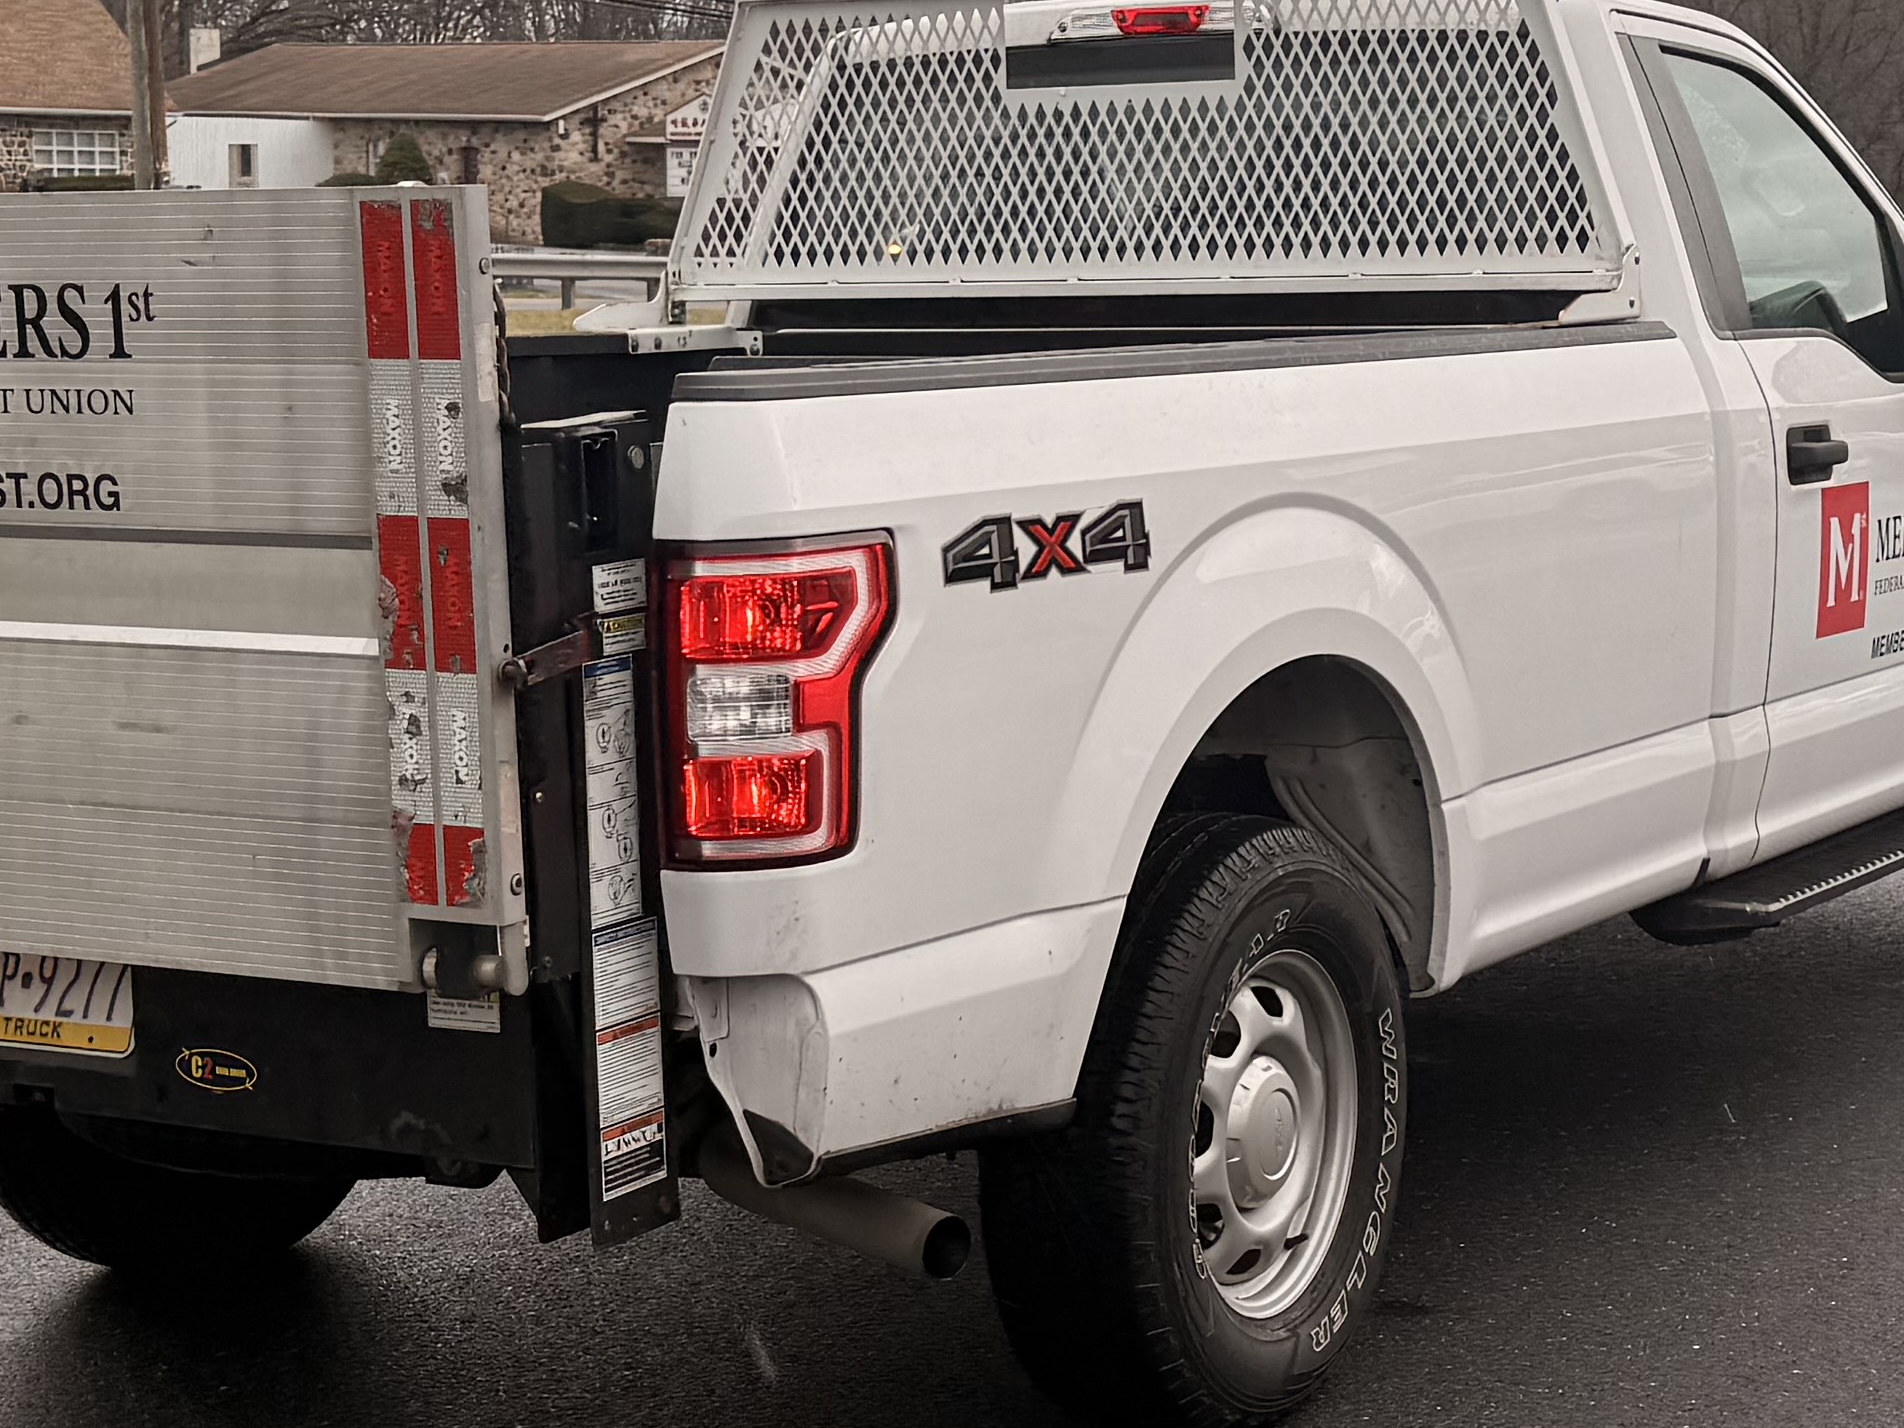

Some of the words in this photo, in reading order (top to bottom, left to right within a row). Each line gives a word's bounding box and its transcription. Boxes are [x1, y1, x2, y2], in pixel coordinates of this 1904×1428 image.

[25, 389, 136, 416] UNION
[386, 398, 403, 470] MAXON
[3, 1017, 63, 1040] TRUCK
[191, 1055, 214, 1080] C2
[1310, 1007, 1399, 1352] WRANGLER
